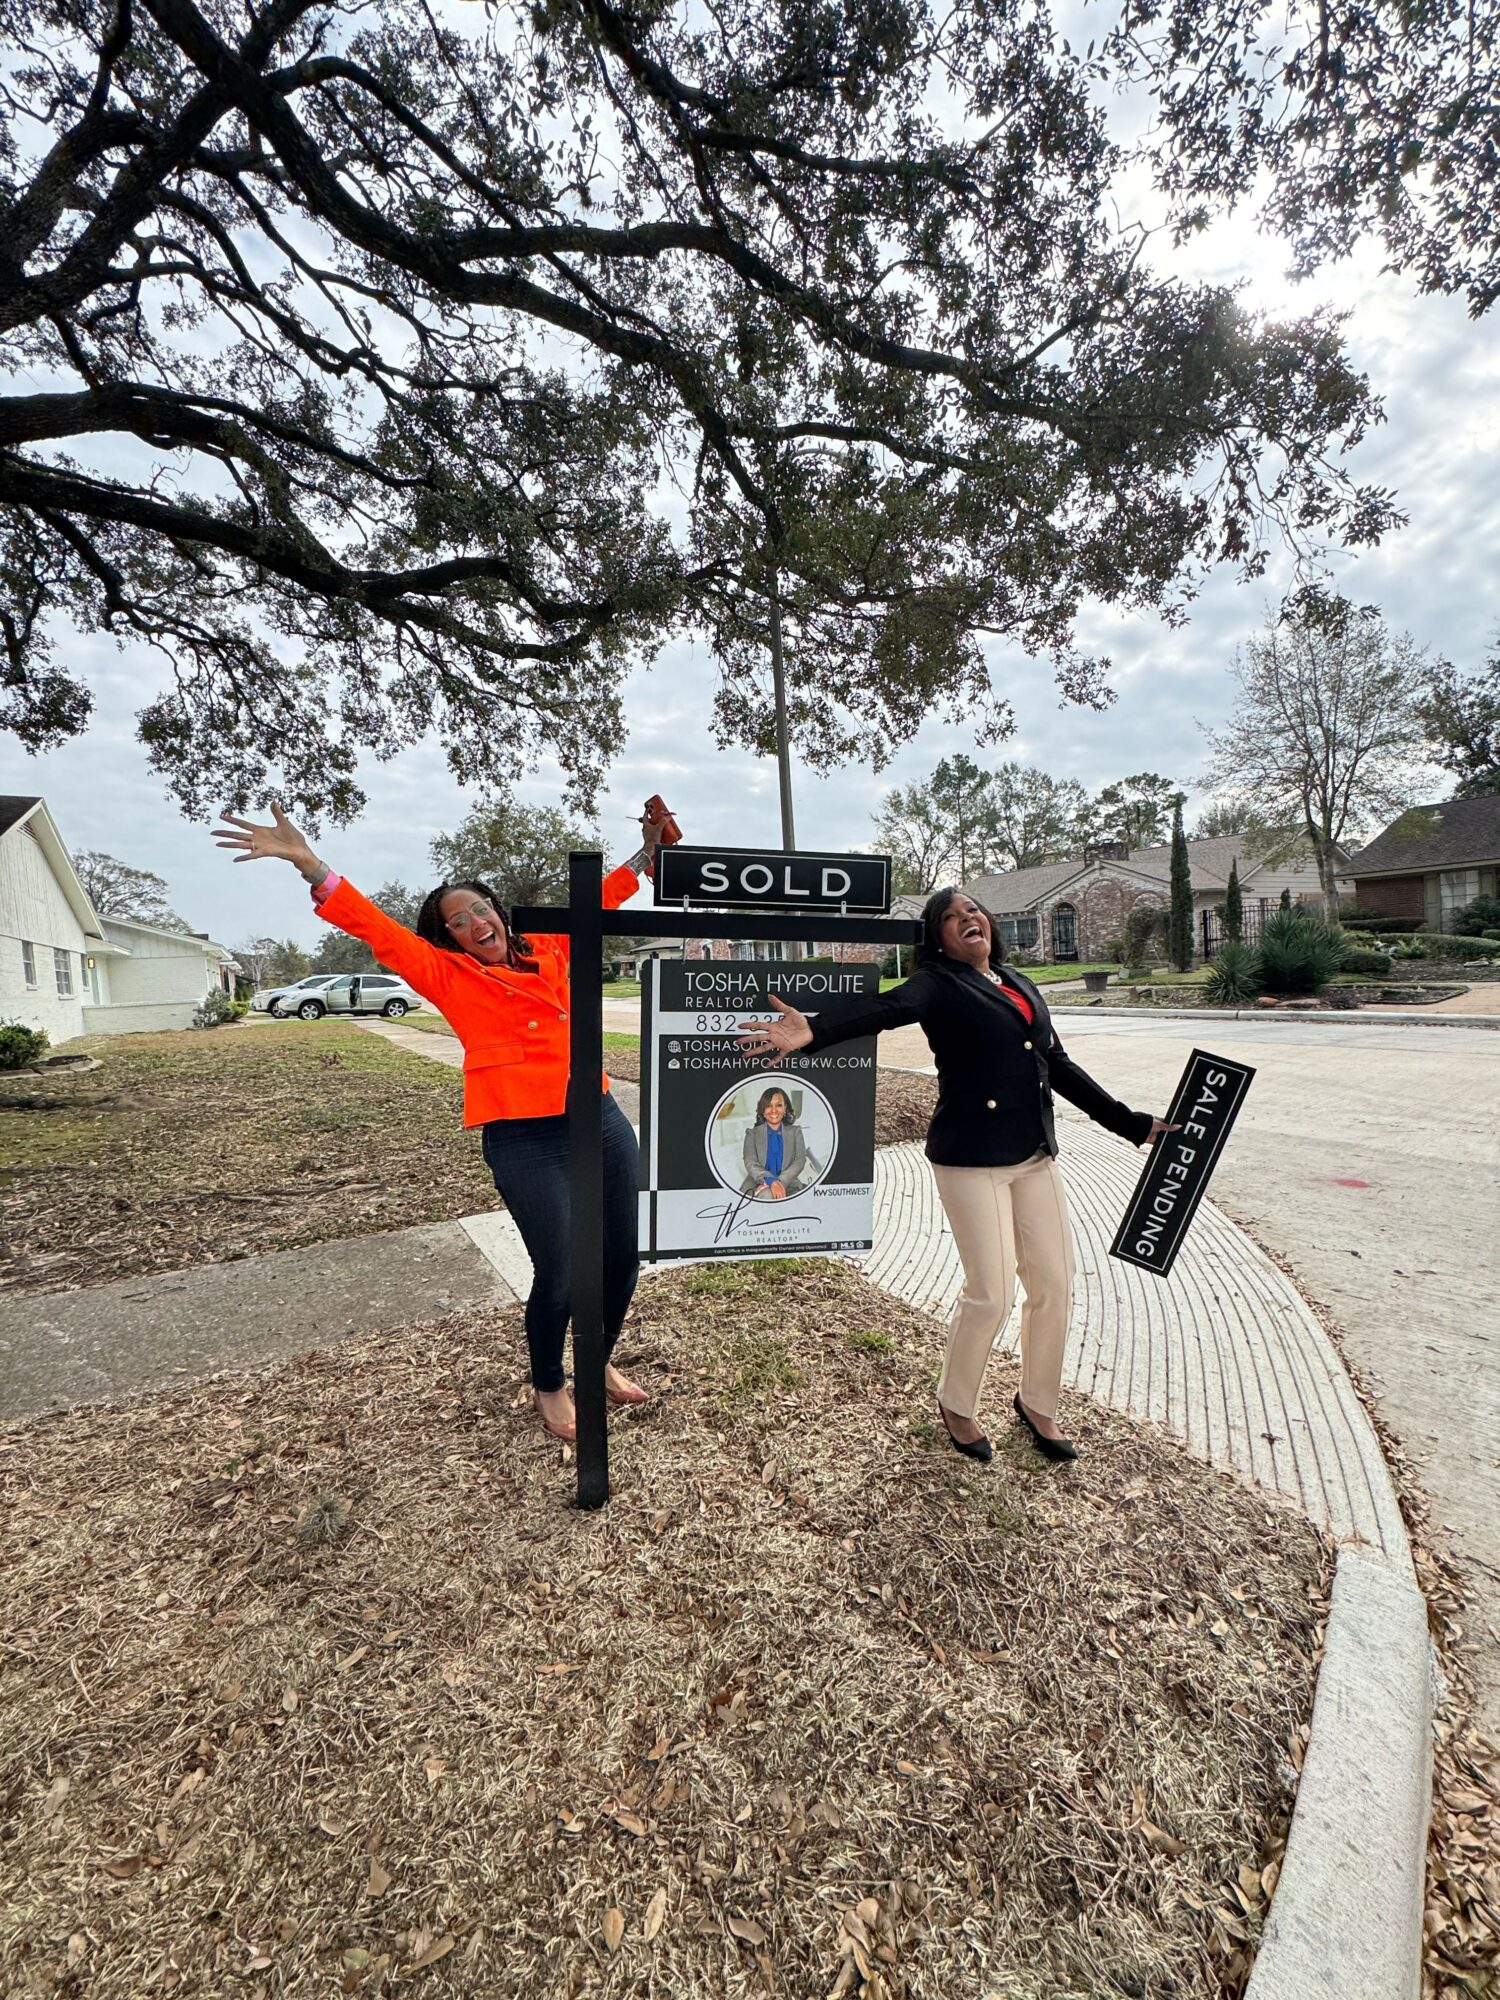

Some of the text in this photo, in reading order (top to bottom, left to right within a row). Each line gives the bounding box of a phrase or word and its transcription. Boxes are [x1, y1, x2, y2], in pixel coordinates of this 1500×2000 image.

[699, 862, 851, 897] SOLD
[685, 973, 864, 993] TOSHA HYPOLITE
[1135, 1069, 1227, 1257] SALE PENDING
